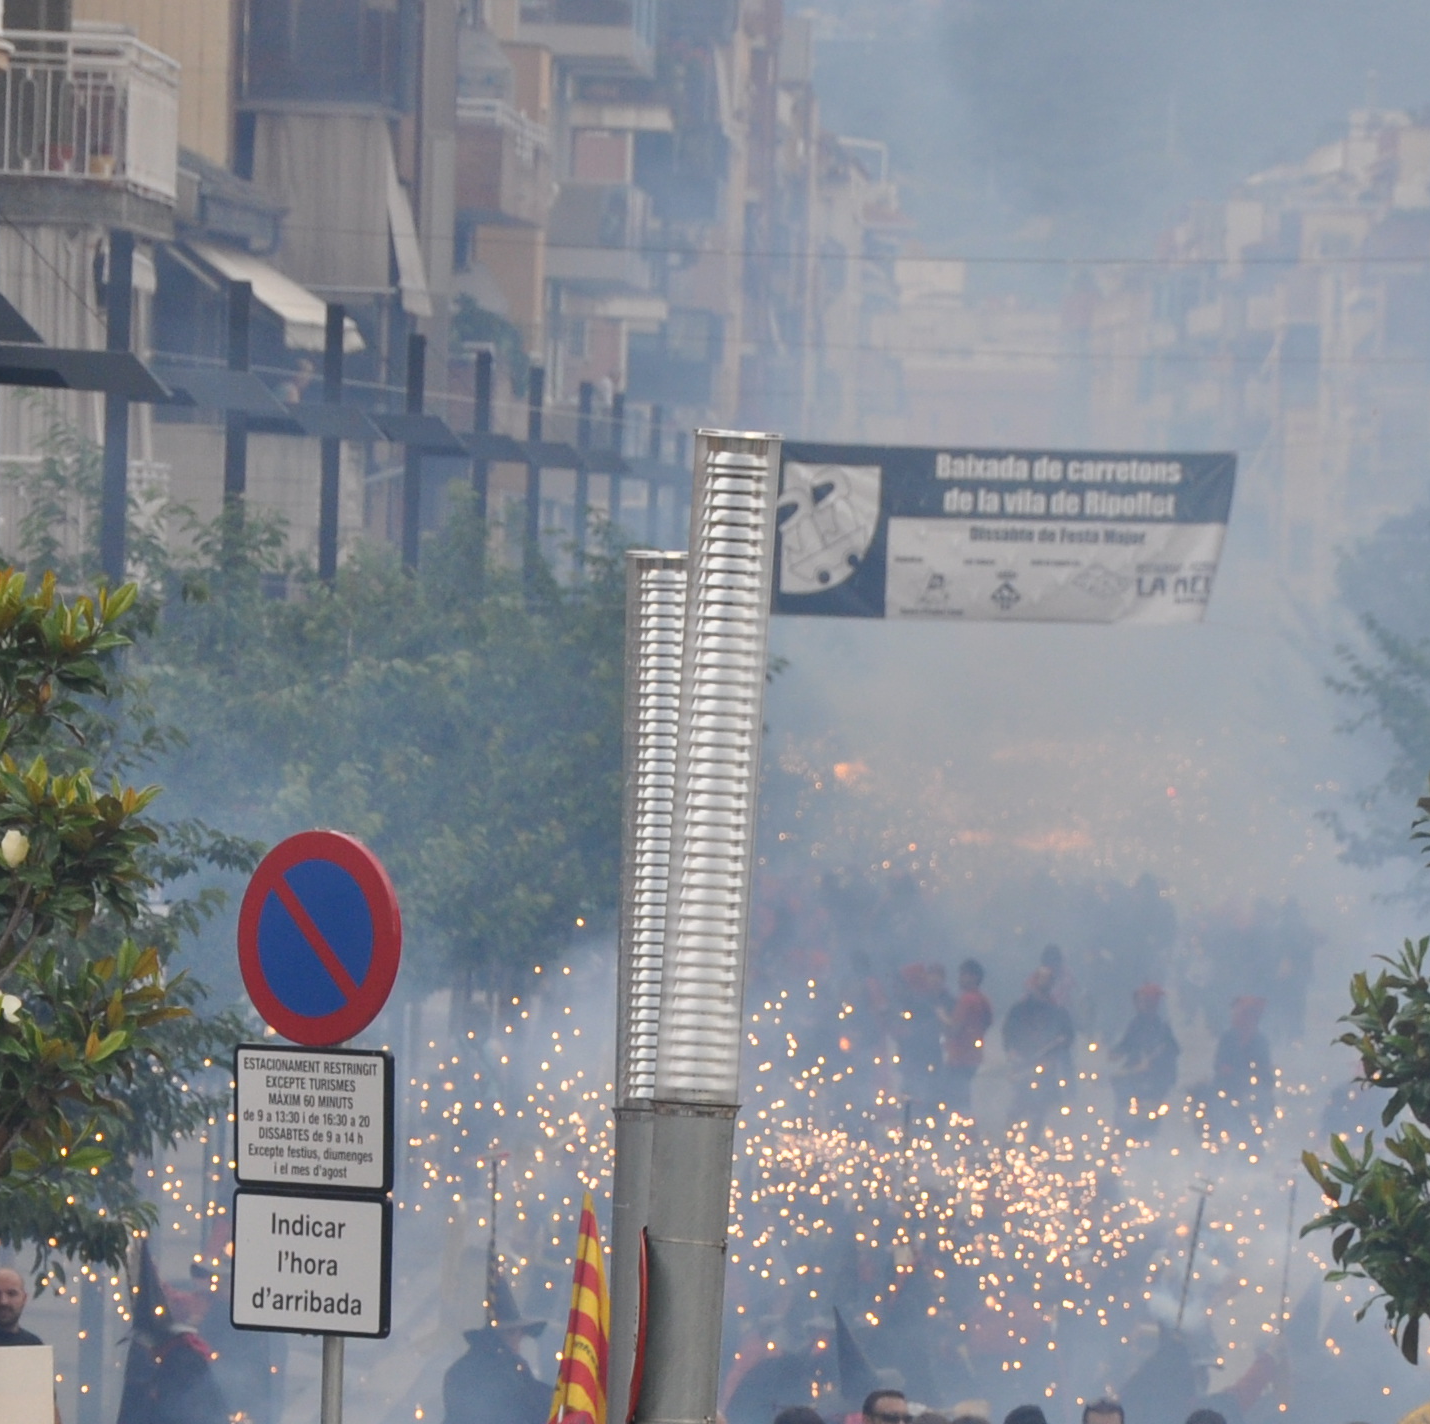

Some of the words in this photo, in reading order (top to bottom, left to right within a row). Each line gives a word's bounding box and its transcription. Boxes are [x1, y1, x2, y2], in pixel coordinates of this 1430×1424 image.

[935, 453, 1029, 480] Baixada
[1032, 456, 1063, 482] de
[1067, 459, 1182, 484] carretons
[943, 487, 974, 513] de
[977, 488, 999, 513] la
[1003, 488, 1046, 514] vila
[1049, 489, 1081, 515] de
[1084, 490, 1176, 518] Ripollet
[969, 525, 1035, 542] Dissabte
[1037, 526, 1056, 542] de
[1059, 527, 1099, 543] Festa
[1104, 529, 1146, 545] Major
[244, 1057, 320, 1074] ESTACIONAMENT
[324, 1062, 377, 1076] RESTRINGIT
[266, 1076, 306, 1089] EXCEPTE
[309, 1078, 356, 1092] TURISMES
[269, 1091, 300, 1106] MÀXIM
[303, 1095, 315, 1107] 60
[318, 1096, 353, 1109] MINUTS
[243, 1109, 255, 1121] de
[257, 1110, 263, 1122] 9
[266, 1113, 272, 1122] a
[275, 1111, 300, 1124] 13:30
[308, 1112, 320, 1124] de
[323, 1113, 347, 1126] 16:30
[350, 1118, 356, 1127] a
[359, 1115, 370, 1127] 20
[258, 1127, 309, 1141] DISSABTES
[312, 1130, 323, 1142] de
[326, 1131, 332, 1142] 9
[335, 1134, 341, 1143] a
[344, 1132, 354, 1144] 14
[357, 1133, 363, 1144] h
[248, 1143, 284, 1159] Excepte
[287, 1145, 321, 1160] festius,
[323, 1148, 373, 1165] diumenges
[280, 1163, 288, 1174] el
[291, 1166, 310, 1176] mes
[313, 1165, 347, 1180] d'agost
[271, 1212, 346, 1239] Indicar
[277, 1250, 338, 1276] l'hora
[251, 1287, 362, 1315] d'arribada
